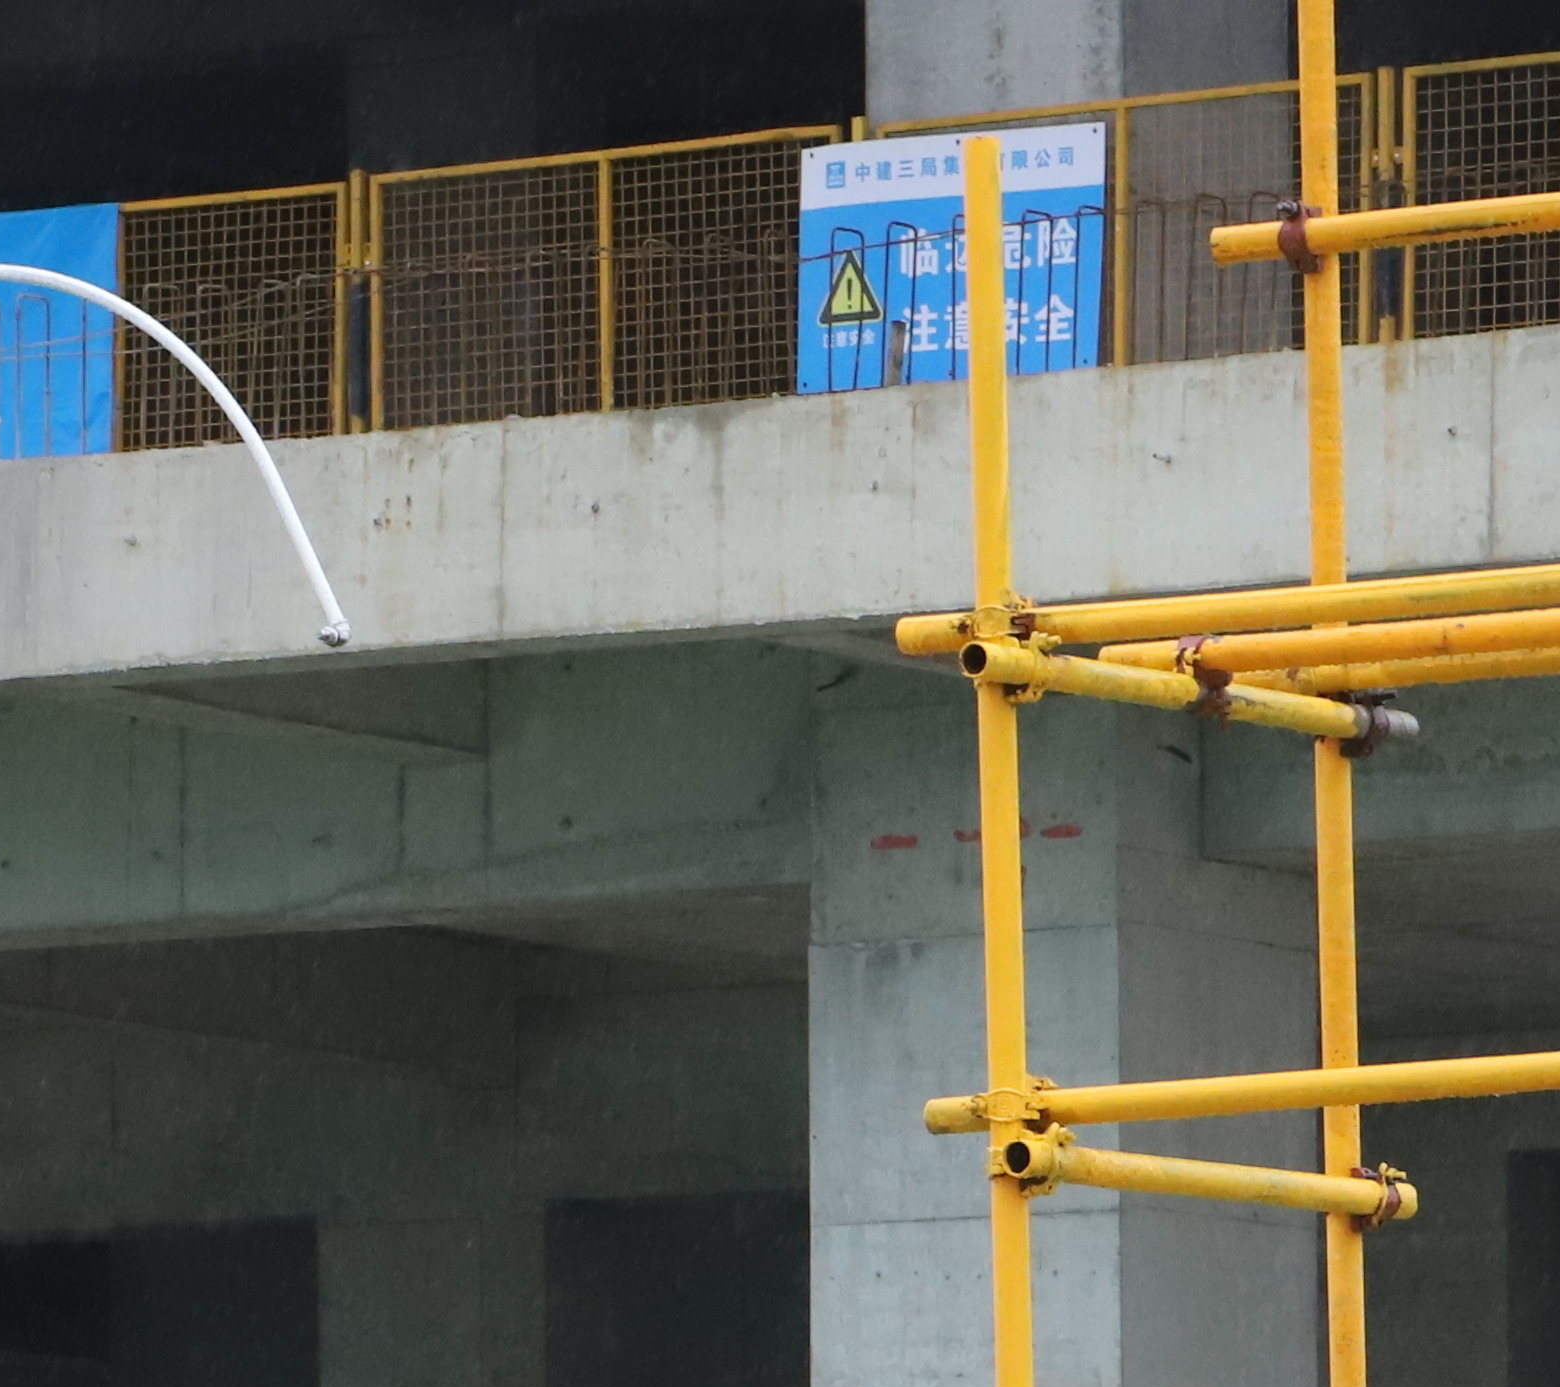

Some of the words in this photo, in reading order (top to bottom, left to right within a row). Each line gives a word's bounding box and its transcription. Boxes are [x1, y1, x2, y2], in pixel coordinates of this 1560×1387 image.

[855, 146, 1075, 182] 中建三局集限公司
